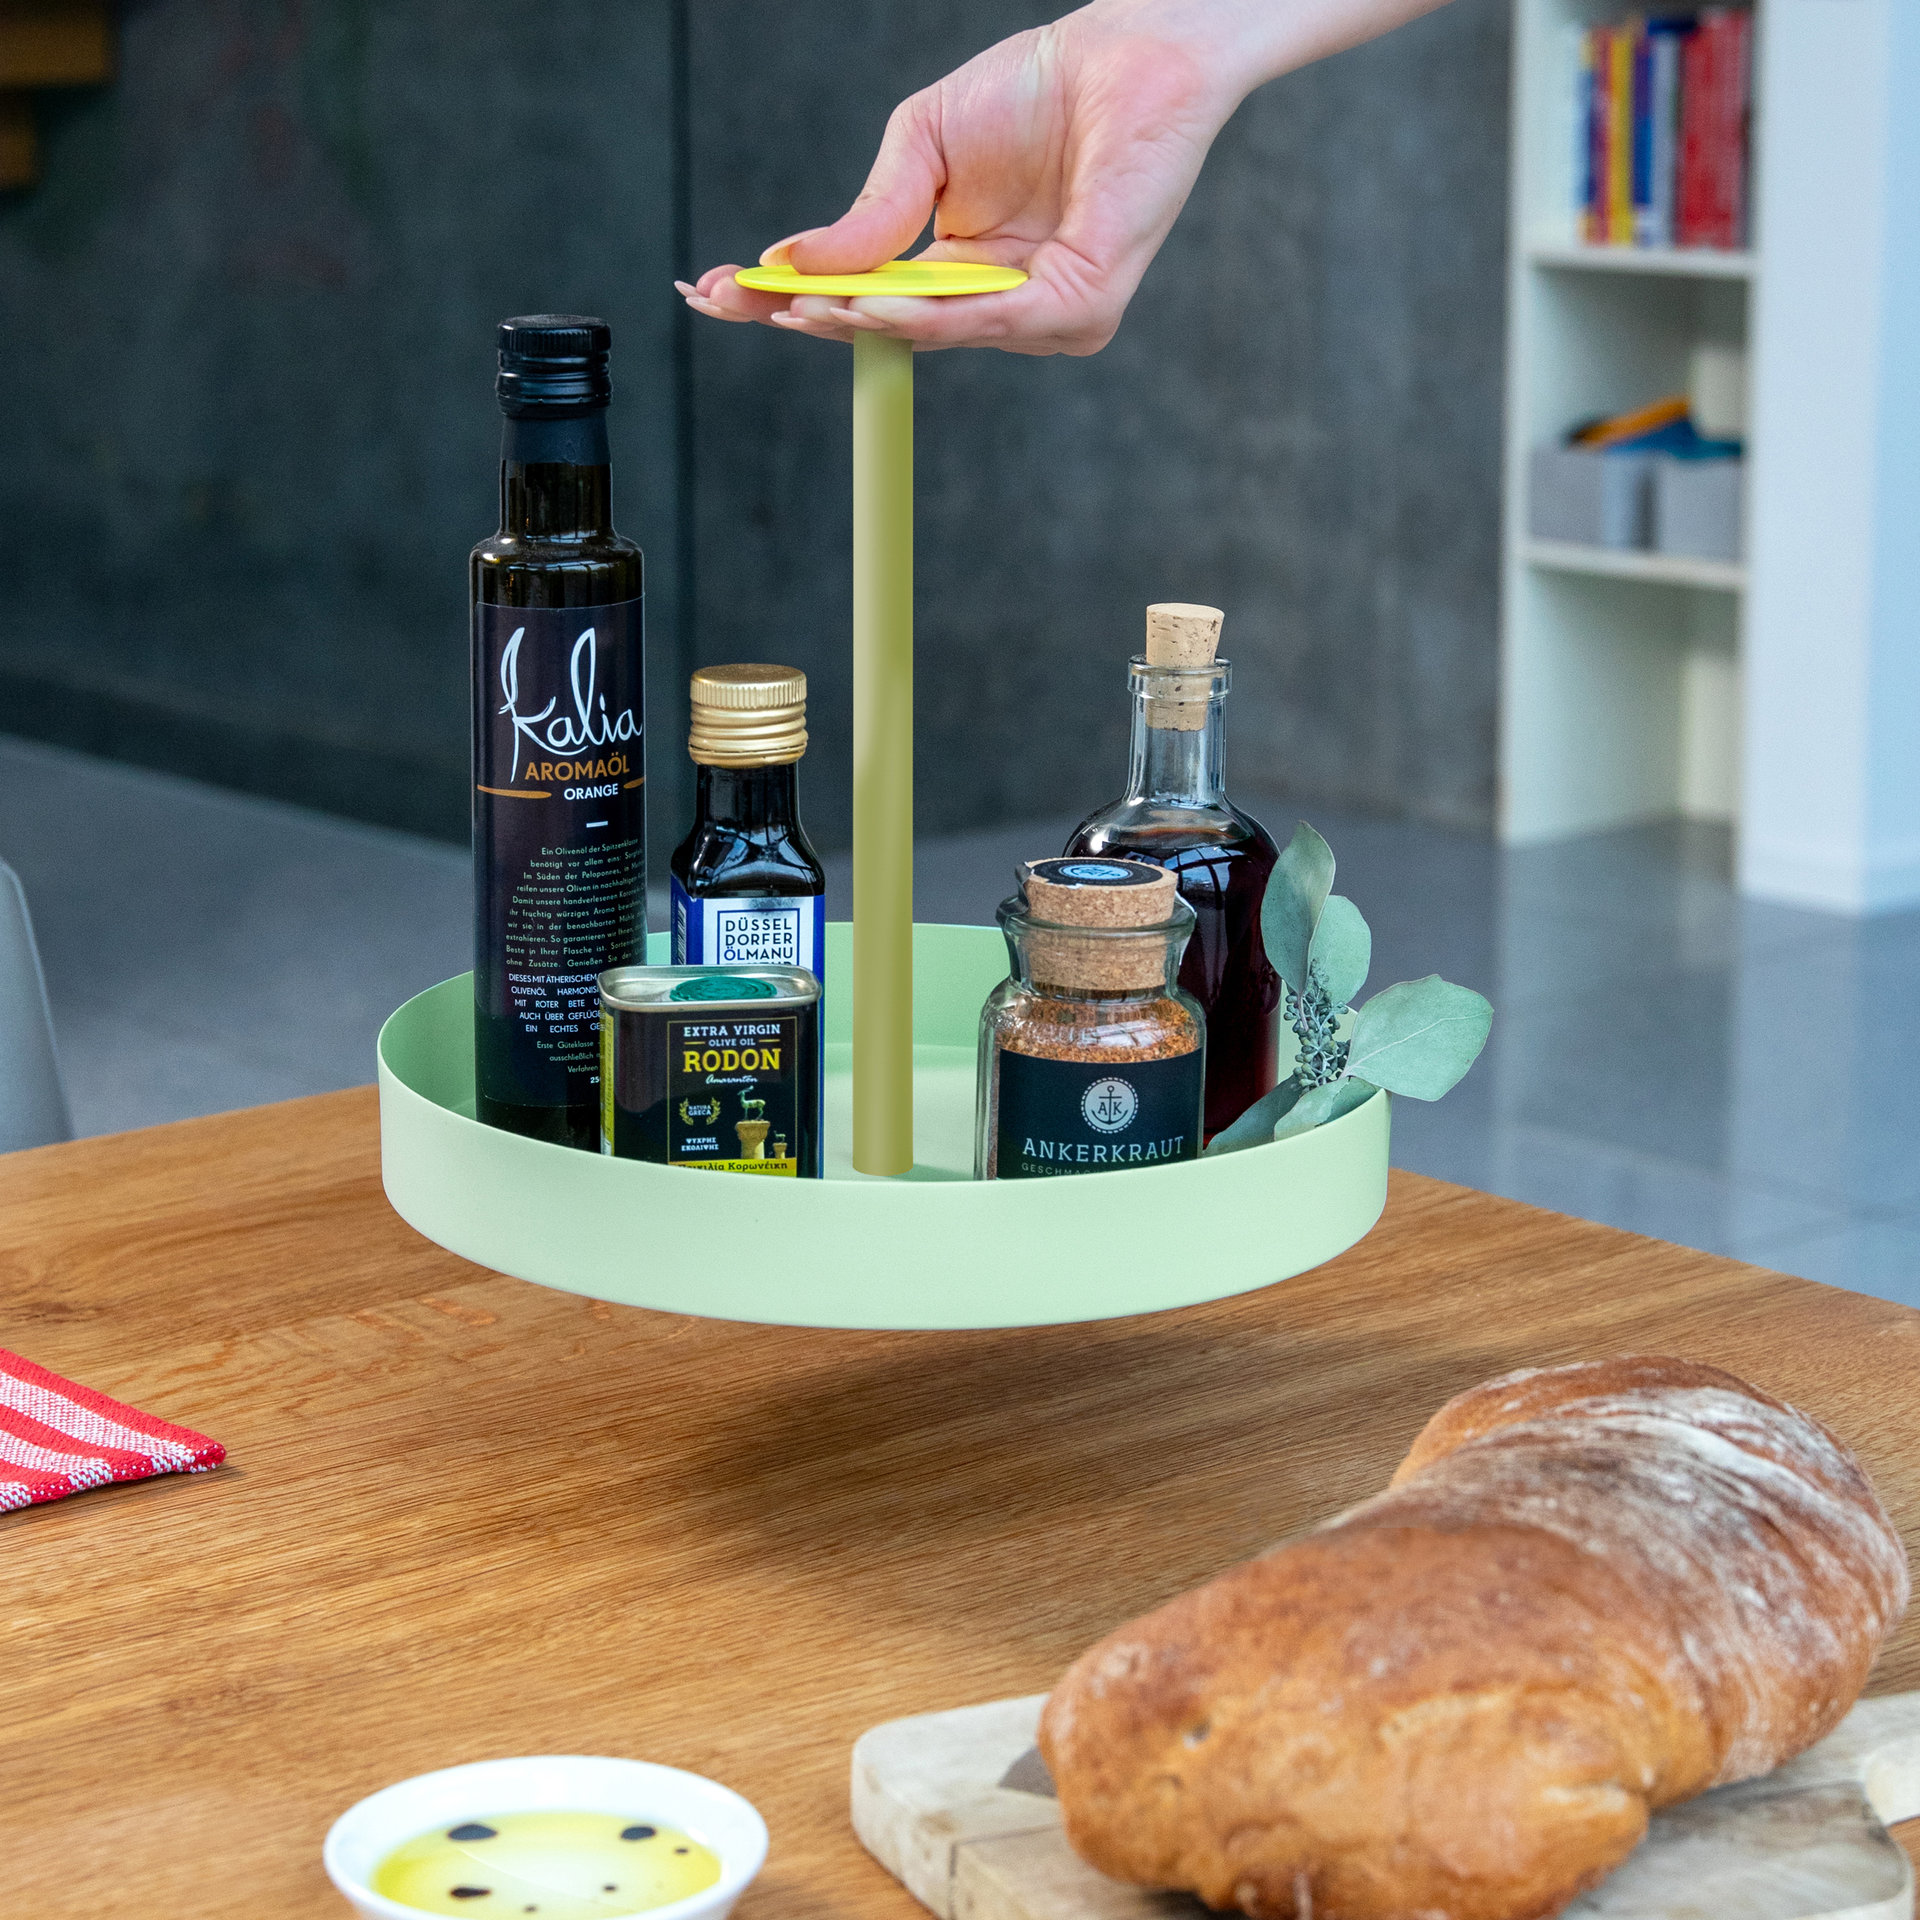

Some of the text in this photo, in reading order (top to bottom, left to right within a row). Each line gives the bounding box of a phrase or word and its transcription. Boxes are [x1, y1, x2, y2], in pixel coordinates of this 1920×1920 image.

[525, 752, 630, 781] AROMAÖL
[564, 783, 618, 800] ORANGE
[555, 847, 587, 856] Olivenöl
[530, 860, 563, 869] benötigt
[537, 872, 560, 880] Süden
[513, 896, 534, 905] Damit
[563, 894, 618, 905] handverlesenen
[522, 910, 551, 919] fruchtig
[557, 910, 589, 919] würziges
[593, 907, 615, 915] Aroma
[522, 922, 533, 930] sie
[537, 922, 544, 930] in
[567, 919, 616, 930] benachbarten
[726, 917, 792, 932] DÜSSEL
[506, 934, 548, 943] extrahieren.
[551, 935, 561, 943] So
[563, 933, 605, 944] garantieren
[726, 933, 792, 946] DORFER
[506, 945, 524, 954] Beste
[564, 947, 592, 955] Flasche
[724, 946, 793, 961] ÖLMANU
[528, 960, 560, 968] Zusätze.
[567, 958, 603, 967] Genießen
[509, 973, 596, 984] DIESES MIT ÄTHERISCHEM
[511, 986, 546, 996] OLIVENÖL
[536, 1000, 559, 1008] ROTER
[568, 1000, 585, 1008] BETE
[594, 998, 600, 1006] U
[520, 1010, 600, 1020] AUCH ÜBER GEFLÜGE
[550, 1025, 578, 1033] ECHTES
[684, 1024, 780, 1037] EXTRA VIRGIN
[558, 1040, 594, 1048] Güteklasse
[708, 1038, 756, 1047] OLIVE OIL
[550, 1053, 594, 1062] ausschließlich
[683, 1048, 781, 1072] RODON
[568, 1064, 598, 1073] Verfahren
[590, 1076, 600, 1084] 25
[1023, 1136, 1184, 1163] ANKERKRAUT
[728, 1161, 788, 1171] Κορωνέικη
